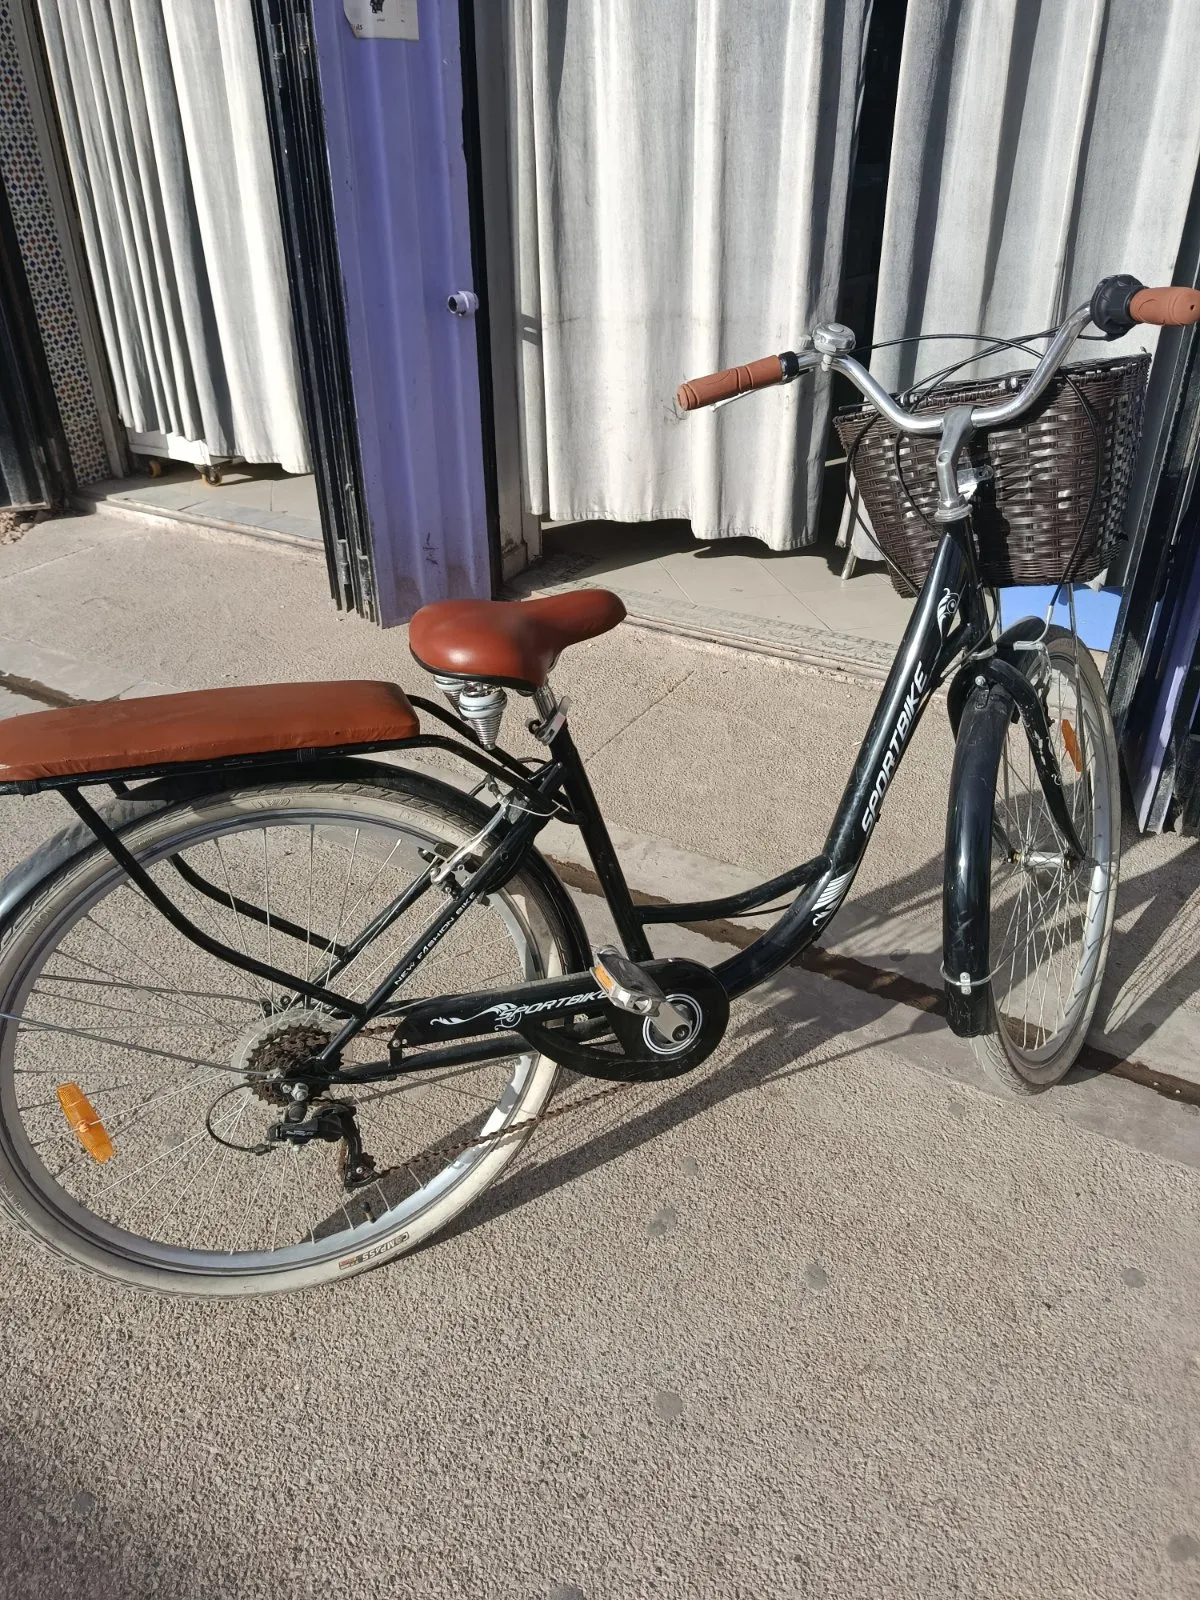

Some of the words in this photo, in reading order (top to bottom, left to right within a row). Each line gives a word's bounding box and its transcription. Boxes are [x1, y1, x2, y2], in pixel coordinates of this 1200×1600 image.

[861, 661, 928, 835] SPORTBIKE
[394, 962, 415, 985] NEW
[416, 916, 455, 959] FASHION
[455, 891, 477, 915] BIKE
